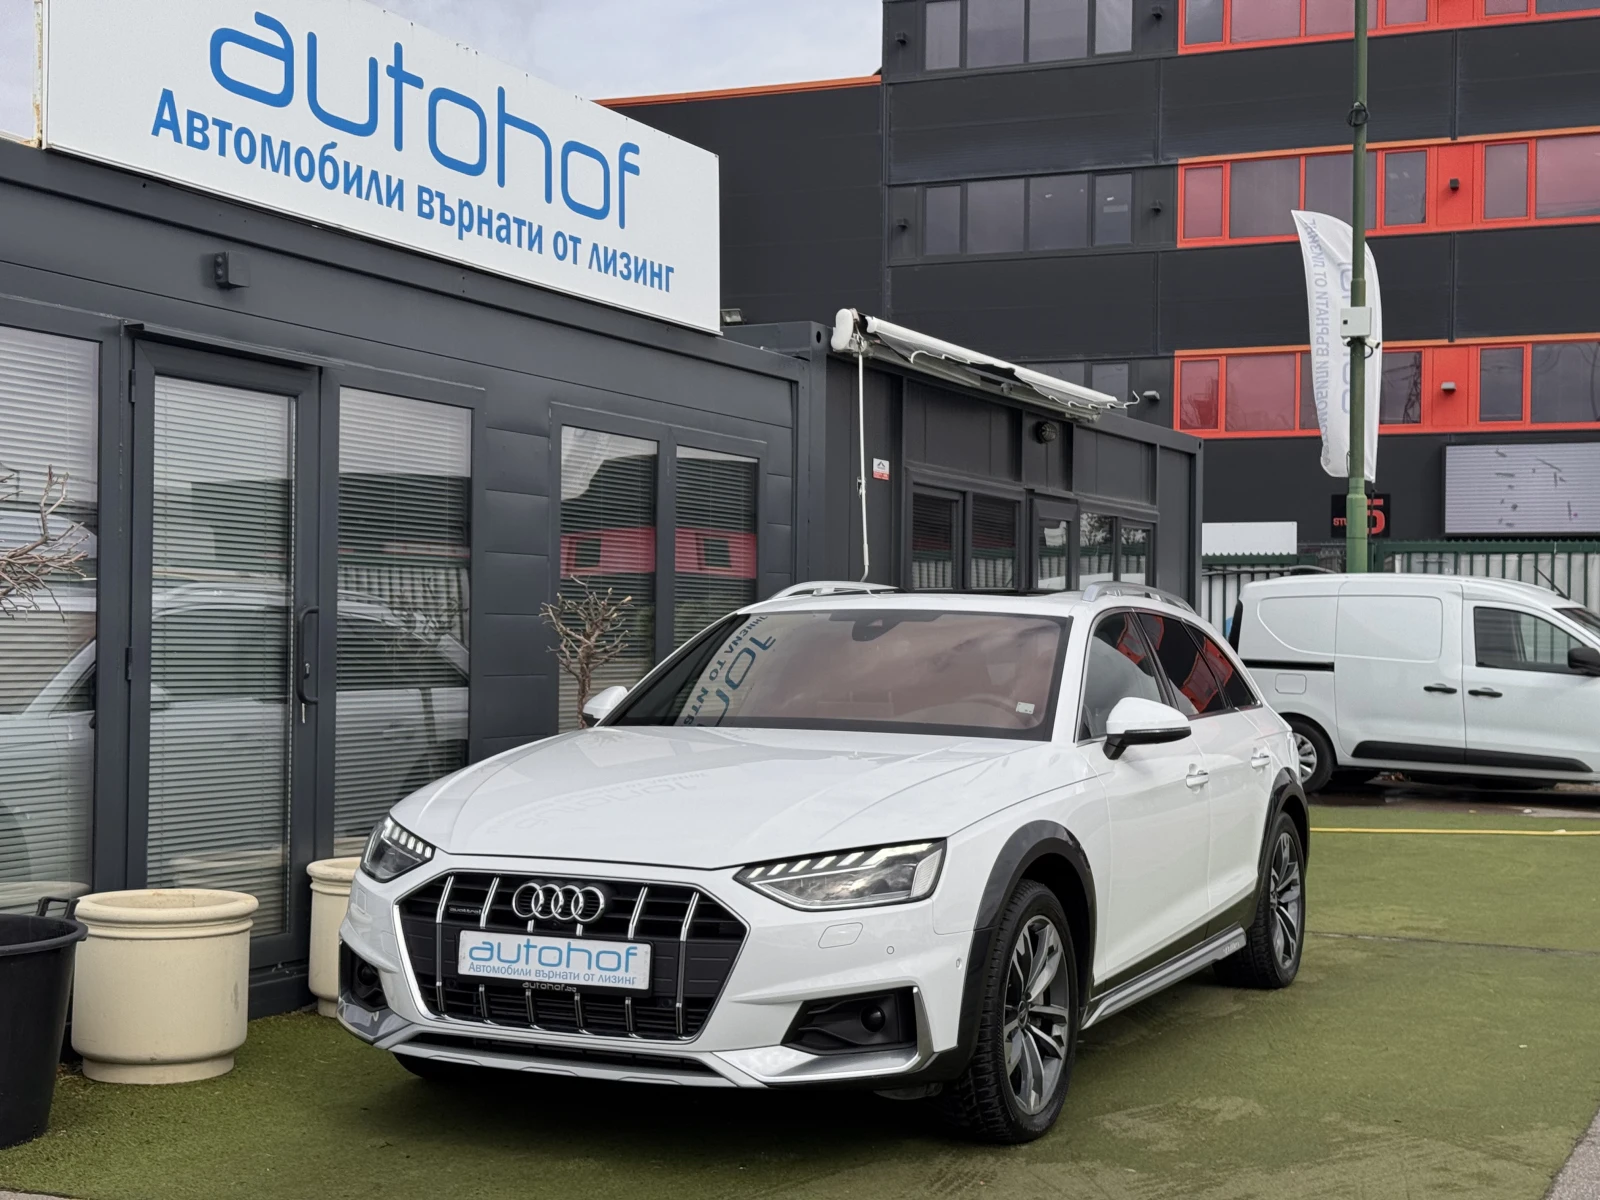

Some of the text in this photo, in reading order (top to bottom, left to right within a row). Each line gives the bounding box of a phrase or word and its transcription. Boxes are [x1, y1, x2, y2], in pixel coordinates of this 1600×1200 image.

[209, 11, 641, 230] autohof
[151, 88, 675, 294] Автомобили върнати от лизинг
[469, 939, 638, 973] autohof
[468, 962, 637, 986] Автомобили върнати от лизинг
[522, 981, 577, 993] autohof.bg
